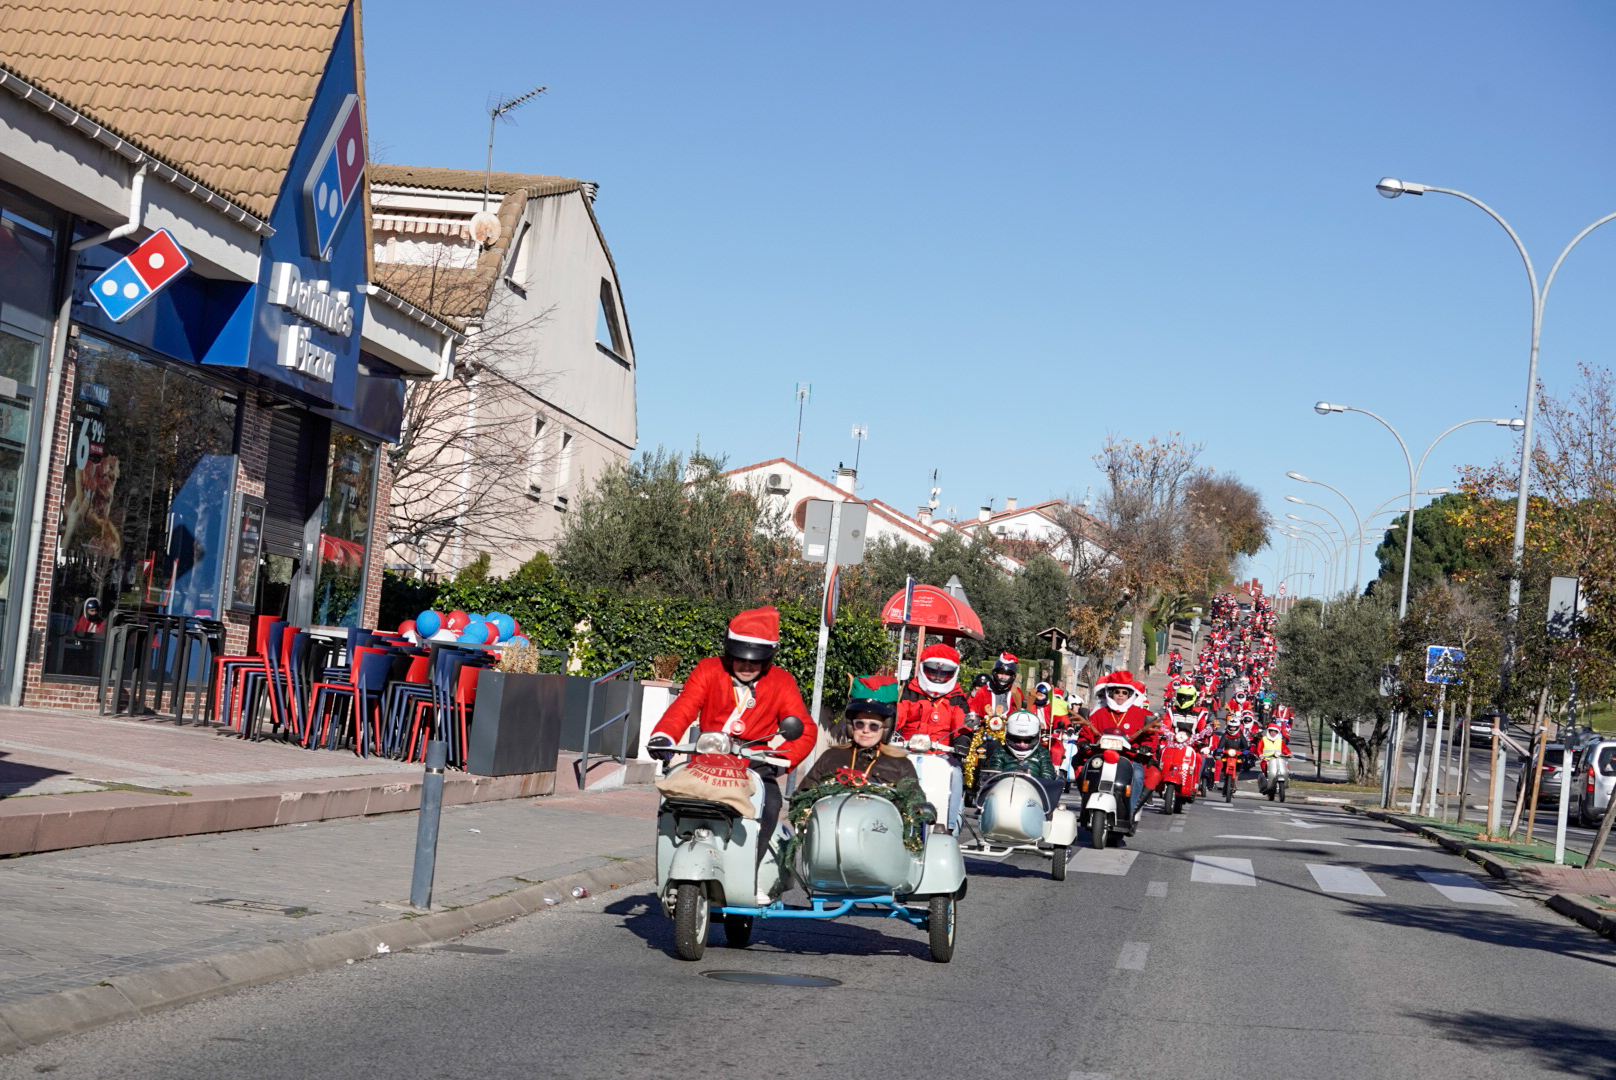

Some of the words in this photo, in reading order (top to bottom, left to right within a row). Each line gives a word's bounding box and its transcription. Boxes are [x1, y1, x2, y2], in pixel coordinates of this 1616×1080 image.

[267, 262, 354, 338] Domino's
[277, 324, 336, 383] Pizza
[689, 769, 709, 784] FROM
[711, 778, 739, 788] SANTA
